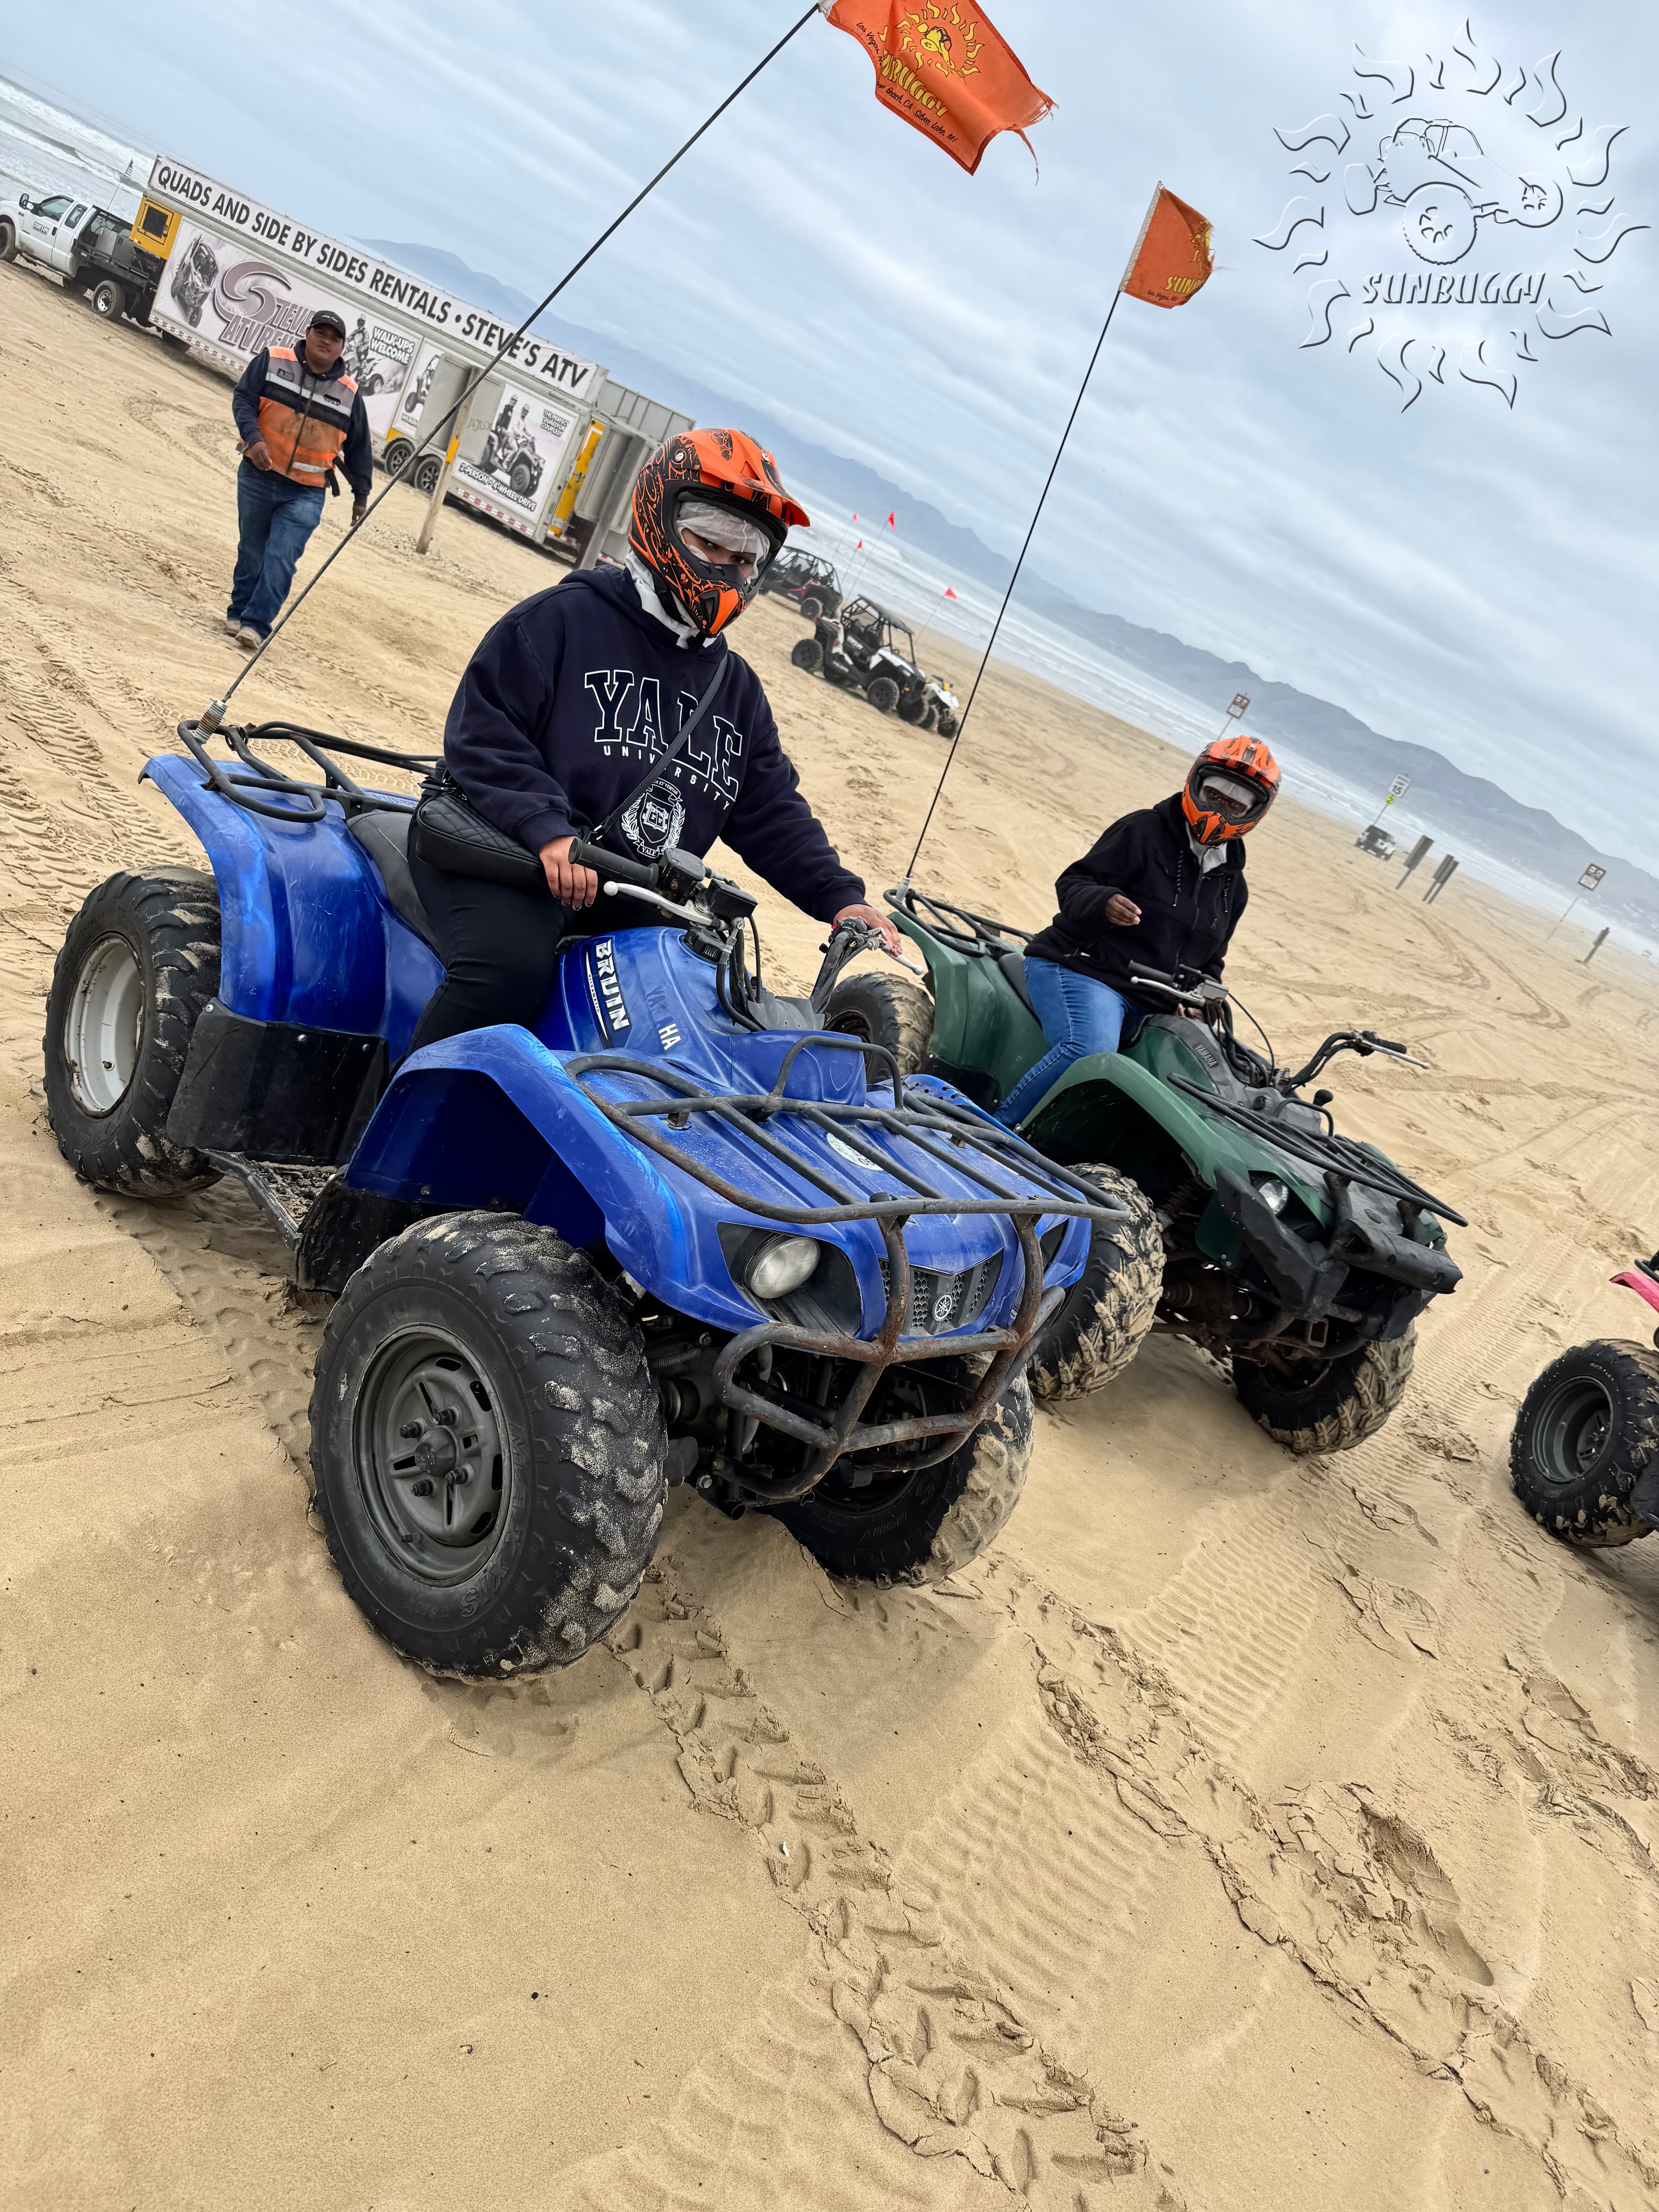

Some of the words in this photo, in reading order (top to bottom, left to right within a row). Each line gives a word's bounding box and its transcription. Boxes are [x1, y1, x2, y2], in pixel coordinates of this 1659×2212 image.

[856, 22, 867, 32] Las
[878, 56, 883, 66] N
[903, 100, 913, 111] CA
[915, 110, 931, 126] Silver
[946, 133, 957, 143] MI
[159, 166, 212, 206] QUADS
[212, 194, 250, 224] AND
[251, 212, 291, 246] SIDE
[291, 231, 318, 257] BY
[317, 244, 368, 283] SIDES
[369, 268, 451, 323] RENTALS
[462, 314, 540, 367] STEVE'S
[540, 353, 589, 388] ATV
[219, 315, 263, 350] ATV
[370, 338, 411, 365] WELCOME
[373, 326, 415, 354] WALK-UPS
[459, 463, 490, 485] 2-PERSON
[517, 495, 537, 512] DRIVE
[585, 670, 742, 802] YALE
[604, 745, 729, 810] UNIVRSITY
[1392, 785, 1402, 795] 15
[642, 847, 656, 856] YALE
[596, 939, 630, 1031] BRUIN
[1194, 1044, 1217, 1067] YAMAHA
